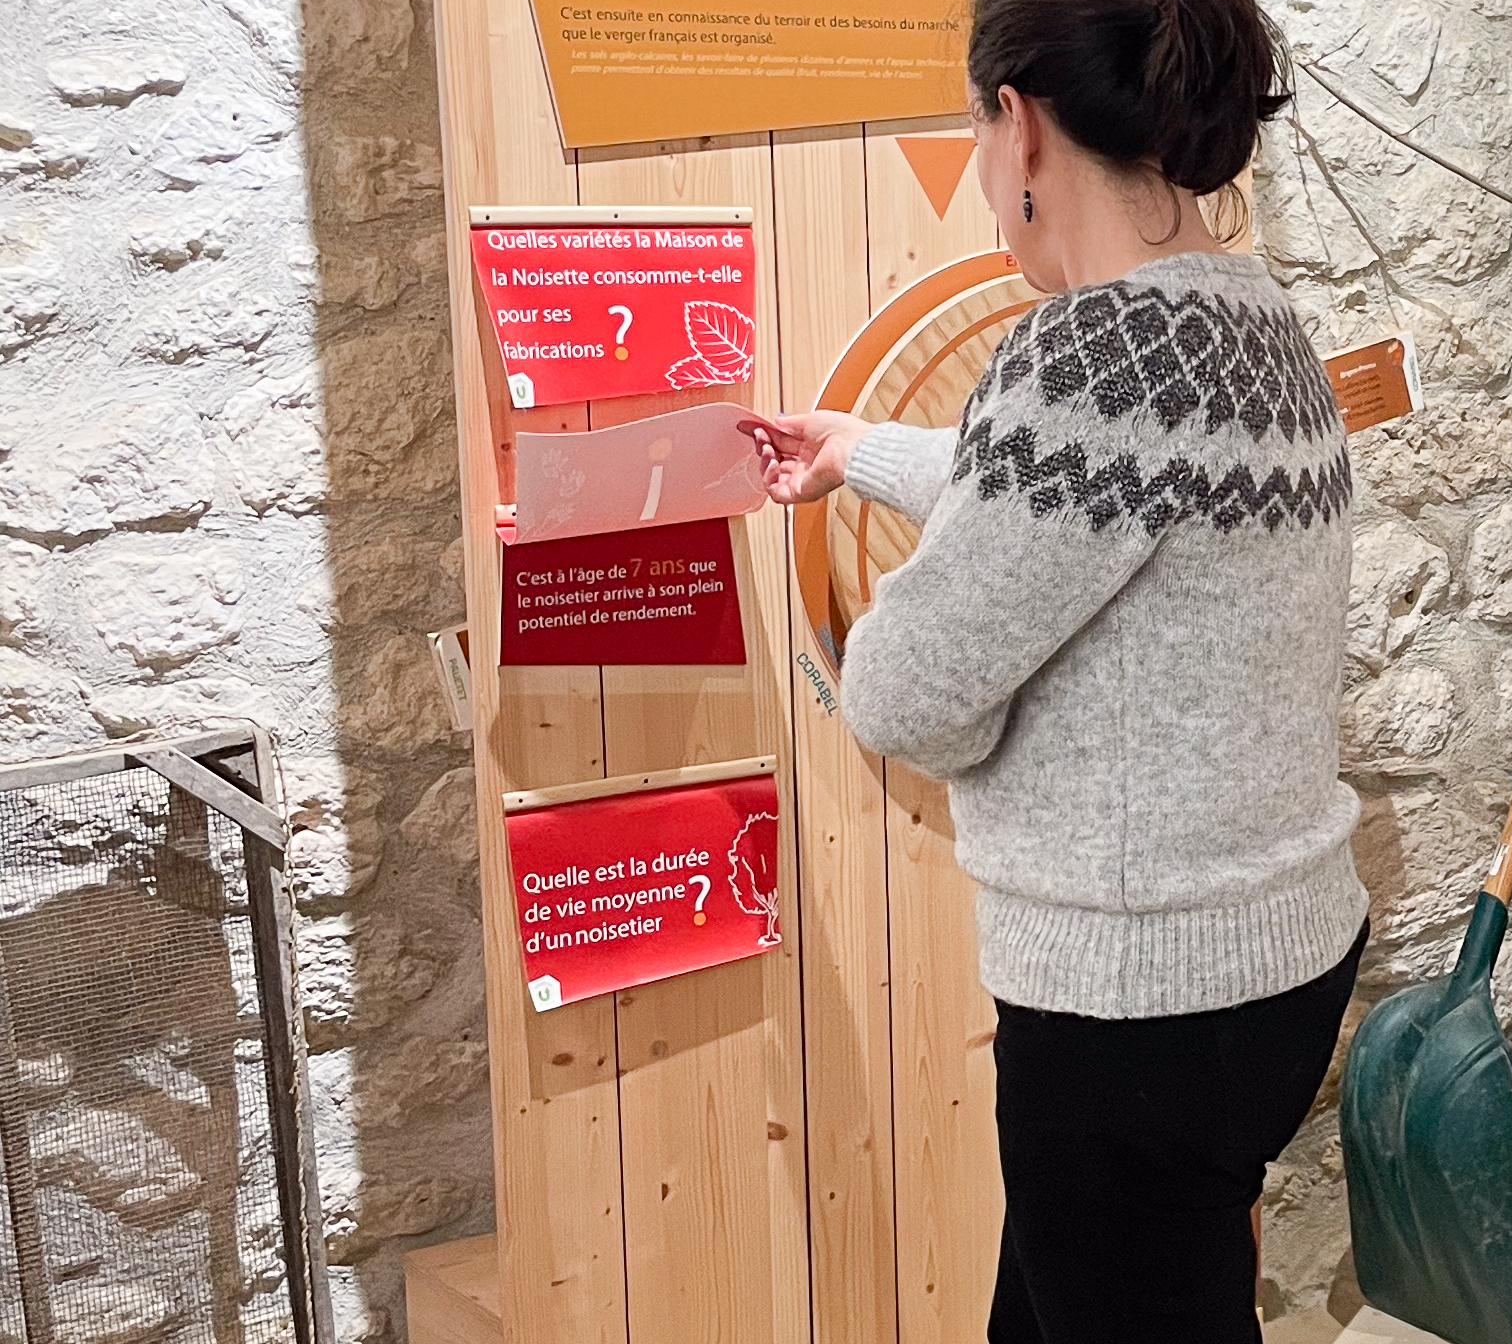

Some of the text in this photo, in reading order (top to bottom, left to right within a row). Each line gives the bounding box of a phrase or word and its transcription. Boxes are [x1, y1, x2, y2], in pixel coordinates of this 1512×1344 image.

[561, 6, 959, 32] C'est ensuite en connaissance du terroir et des besoins du marché
[562, 27, 776, 48] que le verger français est organisé.
[488, 231, 743, 251] Quelles variétés la Maison de
[492, 266, 742, 286] la Noisette consomme-t-elle
[498, 309, 571, 326] pour ses
[504, 305, 633, 360] fabrications ?
[517, 557, 716, 587] C'est à l'âge de 7 ans que
[518, 580, 723, 608] le noisetier arrive à son plein
[519, 604, 696, 633] potentiel de rendement.
[796, 653, 838, 717] CORABEL
[523, 848, 709, 893] Quelle est la durée
[525, 875, 711, 926] de vie moyenne ?
[526, 916, 662, 953] d'un noisetier
